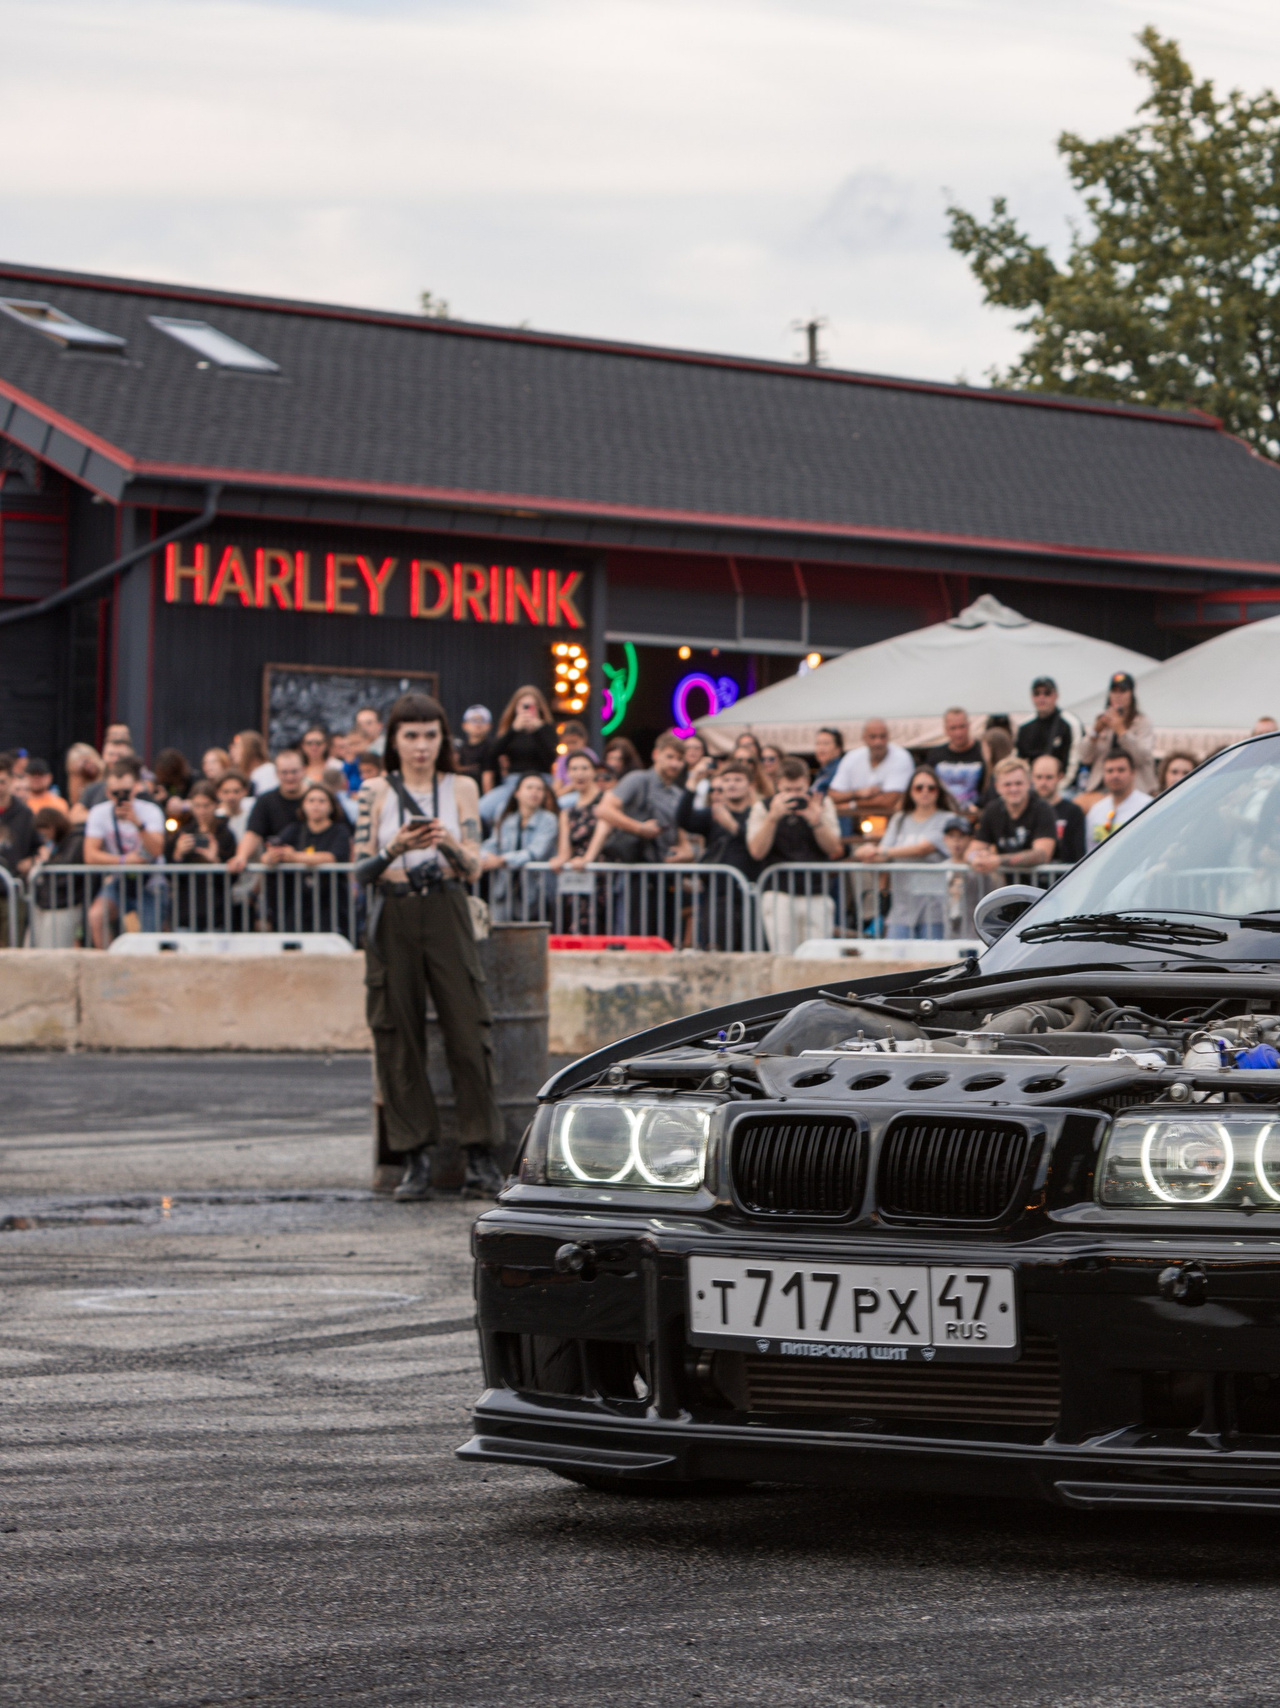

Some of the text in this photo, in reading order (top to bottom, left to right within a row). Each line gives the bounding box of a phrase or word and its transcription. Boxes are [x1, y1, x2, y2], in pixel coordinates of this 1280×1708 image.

[165, 541, 586, 629] HARLEY DRINK
[938, 1273, 992, 1321] 47
[944, 1321, 988, 1341] RUS
[780, 1341, 868, 1360] ПИТЕРСКИЙ
